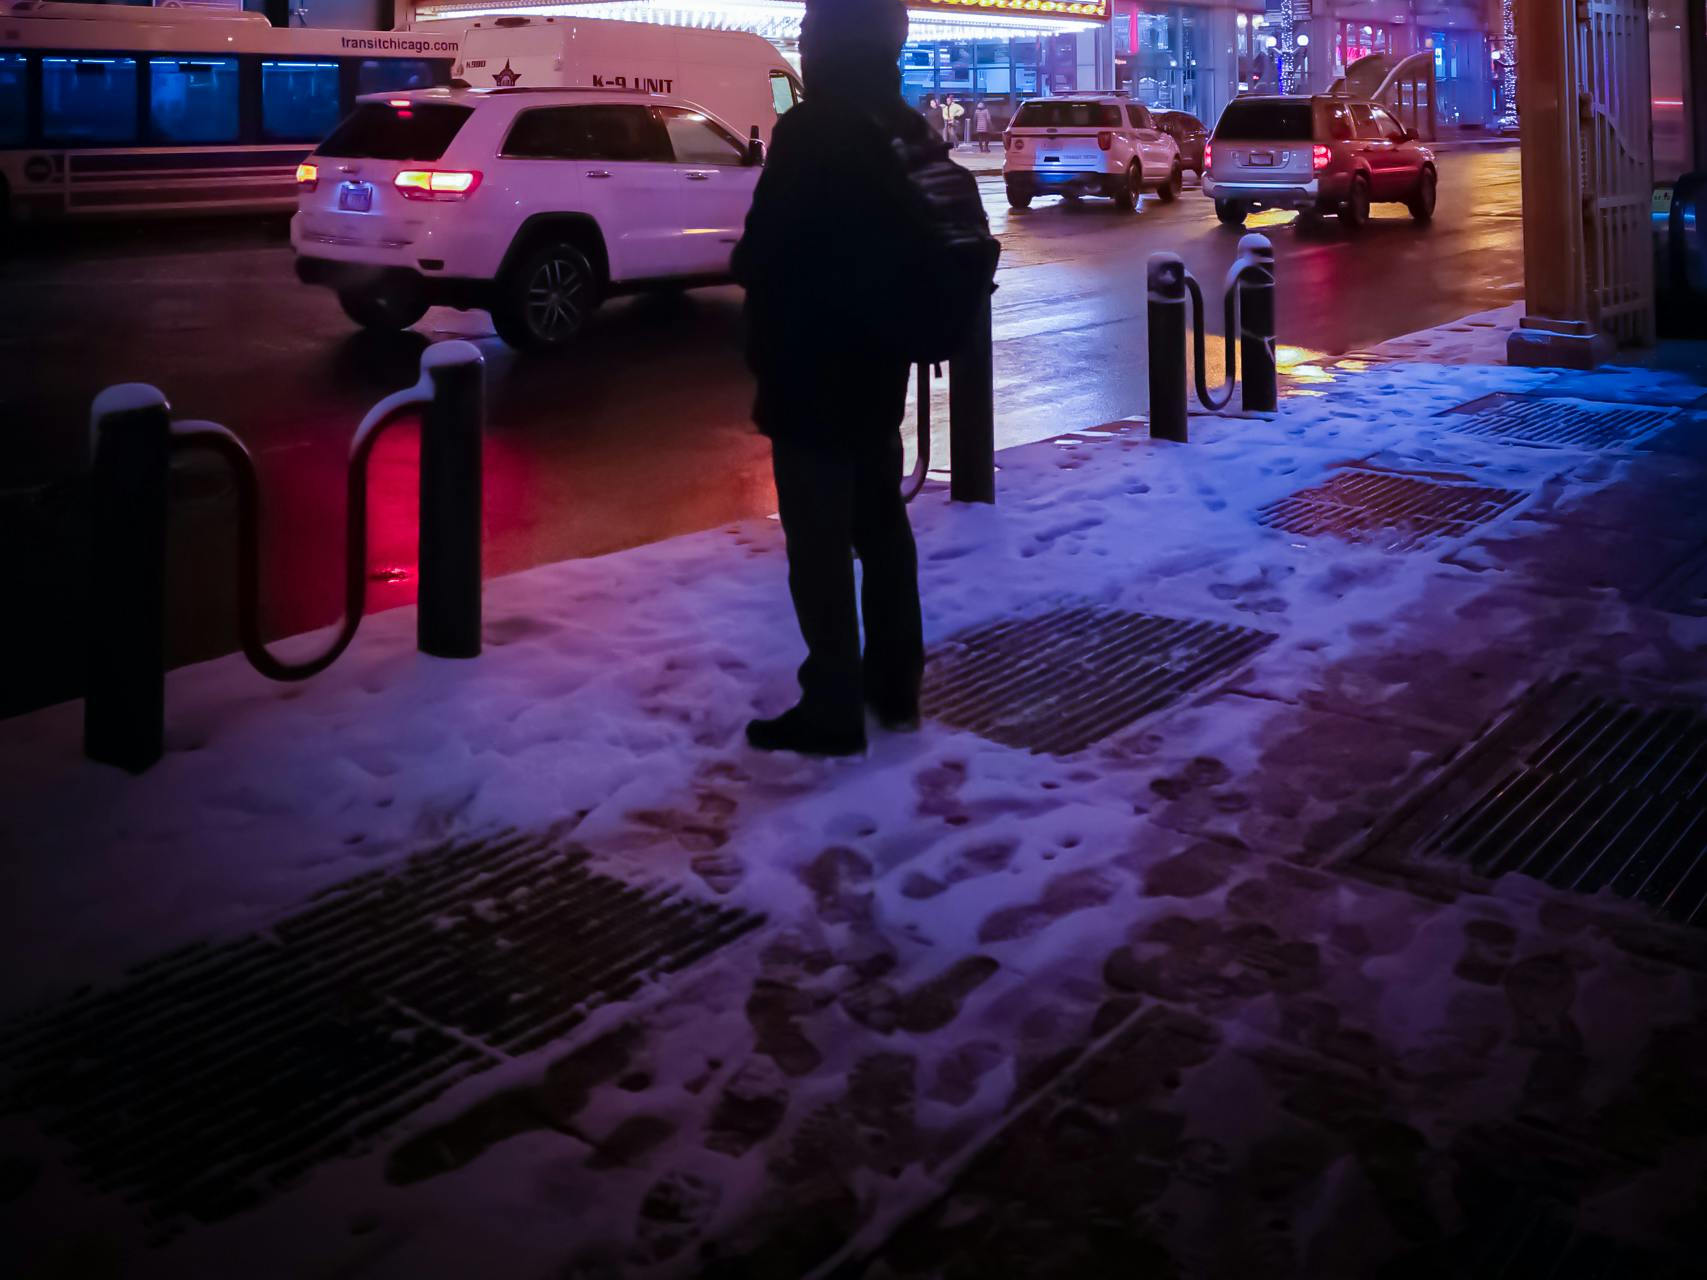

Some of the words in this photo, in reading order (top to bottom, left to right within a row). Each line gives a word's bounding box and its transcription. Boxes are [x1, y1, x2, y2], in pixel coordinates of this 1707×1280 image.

[341, 36, 459, 53] transitchicago.com
[592, 74, 627, 89] K-9
[634, 77, 673, 94] UNIT
